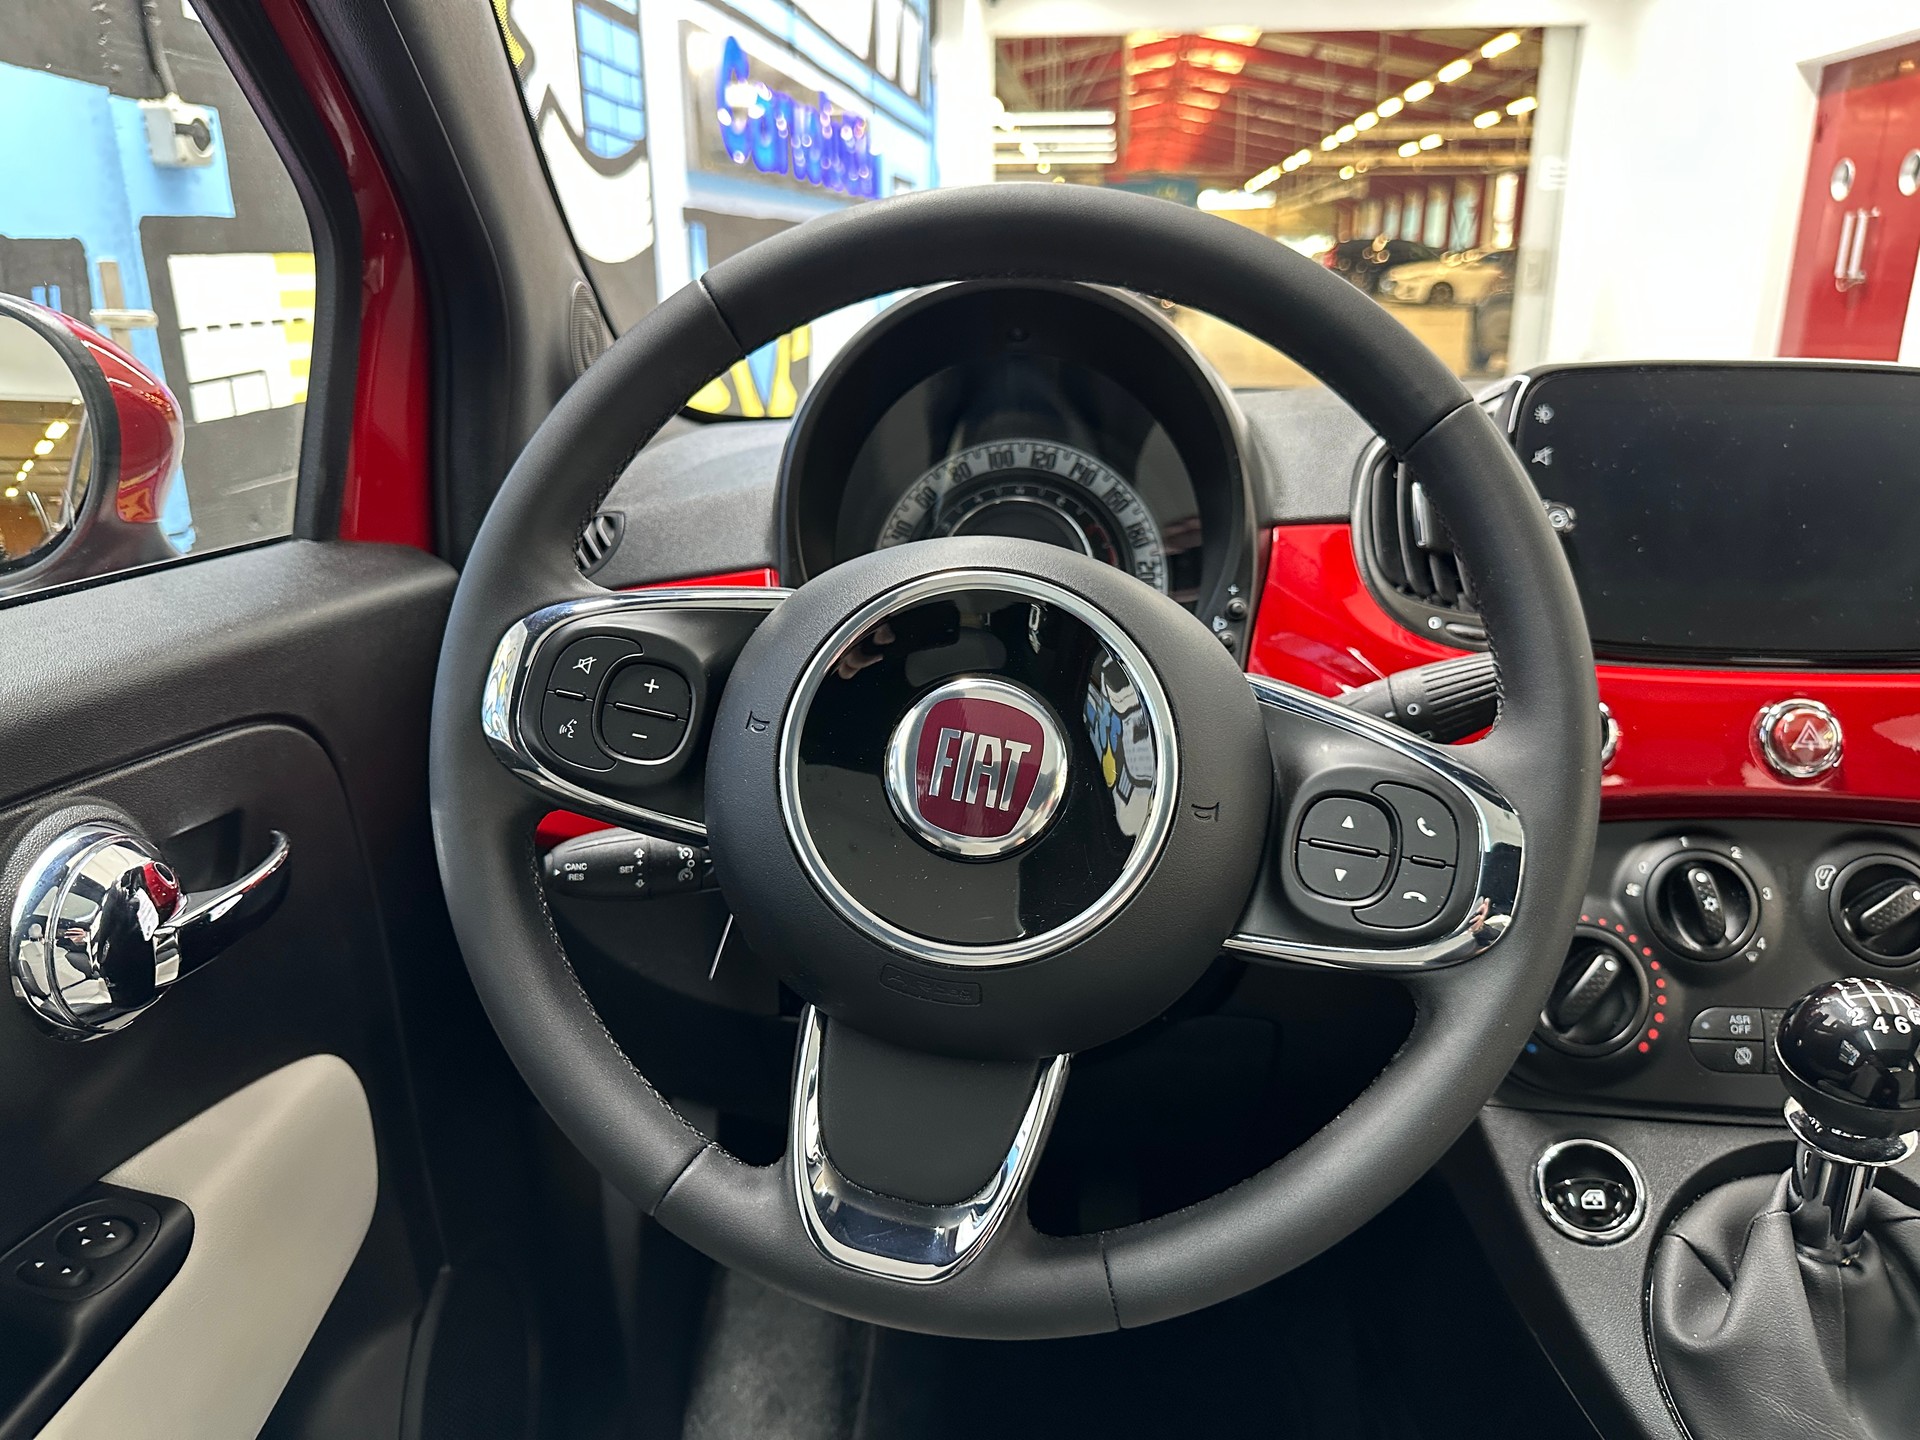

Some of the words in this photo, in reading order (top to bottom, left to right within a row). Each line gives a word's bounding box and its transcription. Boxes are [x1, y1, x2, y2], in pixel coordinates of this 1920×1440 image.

[988, 449, 1015, 469] 100
[1030, 450, 1057, 470] 120
[1070, 460, 1097, 487] 140
[1101, 486, 1129, 513] 160
[1127, 522, 1150, 549] 180
[928, 726, 1032, 812] FIAT
[1679, 836, 1690, 849] 1
[1730, 845, 1744, 860] 2
[564, 862, 588, 872] CANC
[619, 865, 635, 875] SET
[567, 872, 585, 882] RES
[1762, 886, 1774, 902] 3
[1756, 936, 1767, 951] 4
[1728, 1014, 1751, 1025] ASR
[1850, 1006, 1868, 1027] 2
[1872, 1015, 1890, 1035] 4
[1893, 1015, 1912, 1035] 6
[1729, 1024, 1751, 1035] OFF
